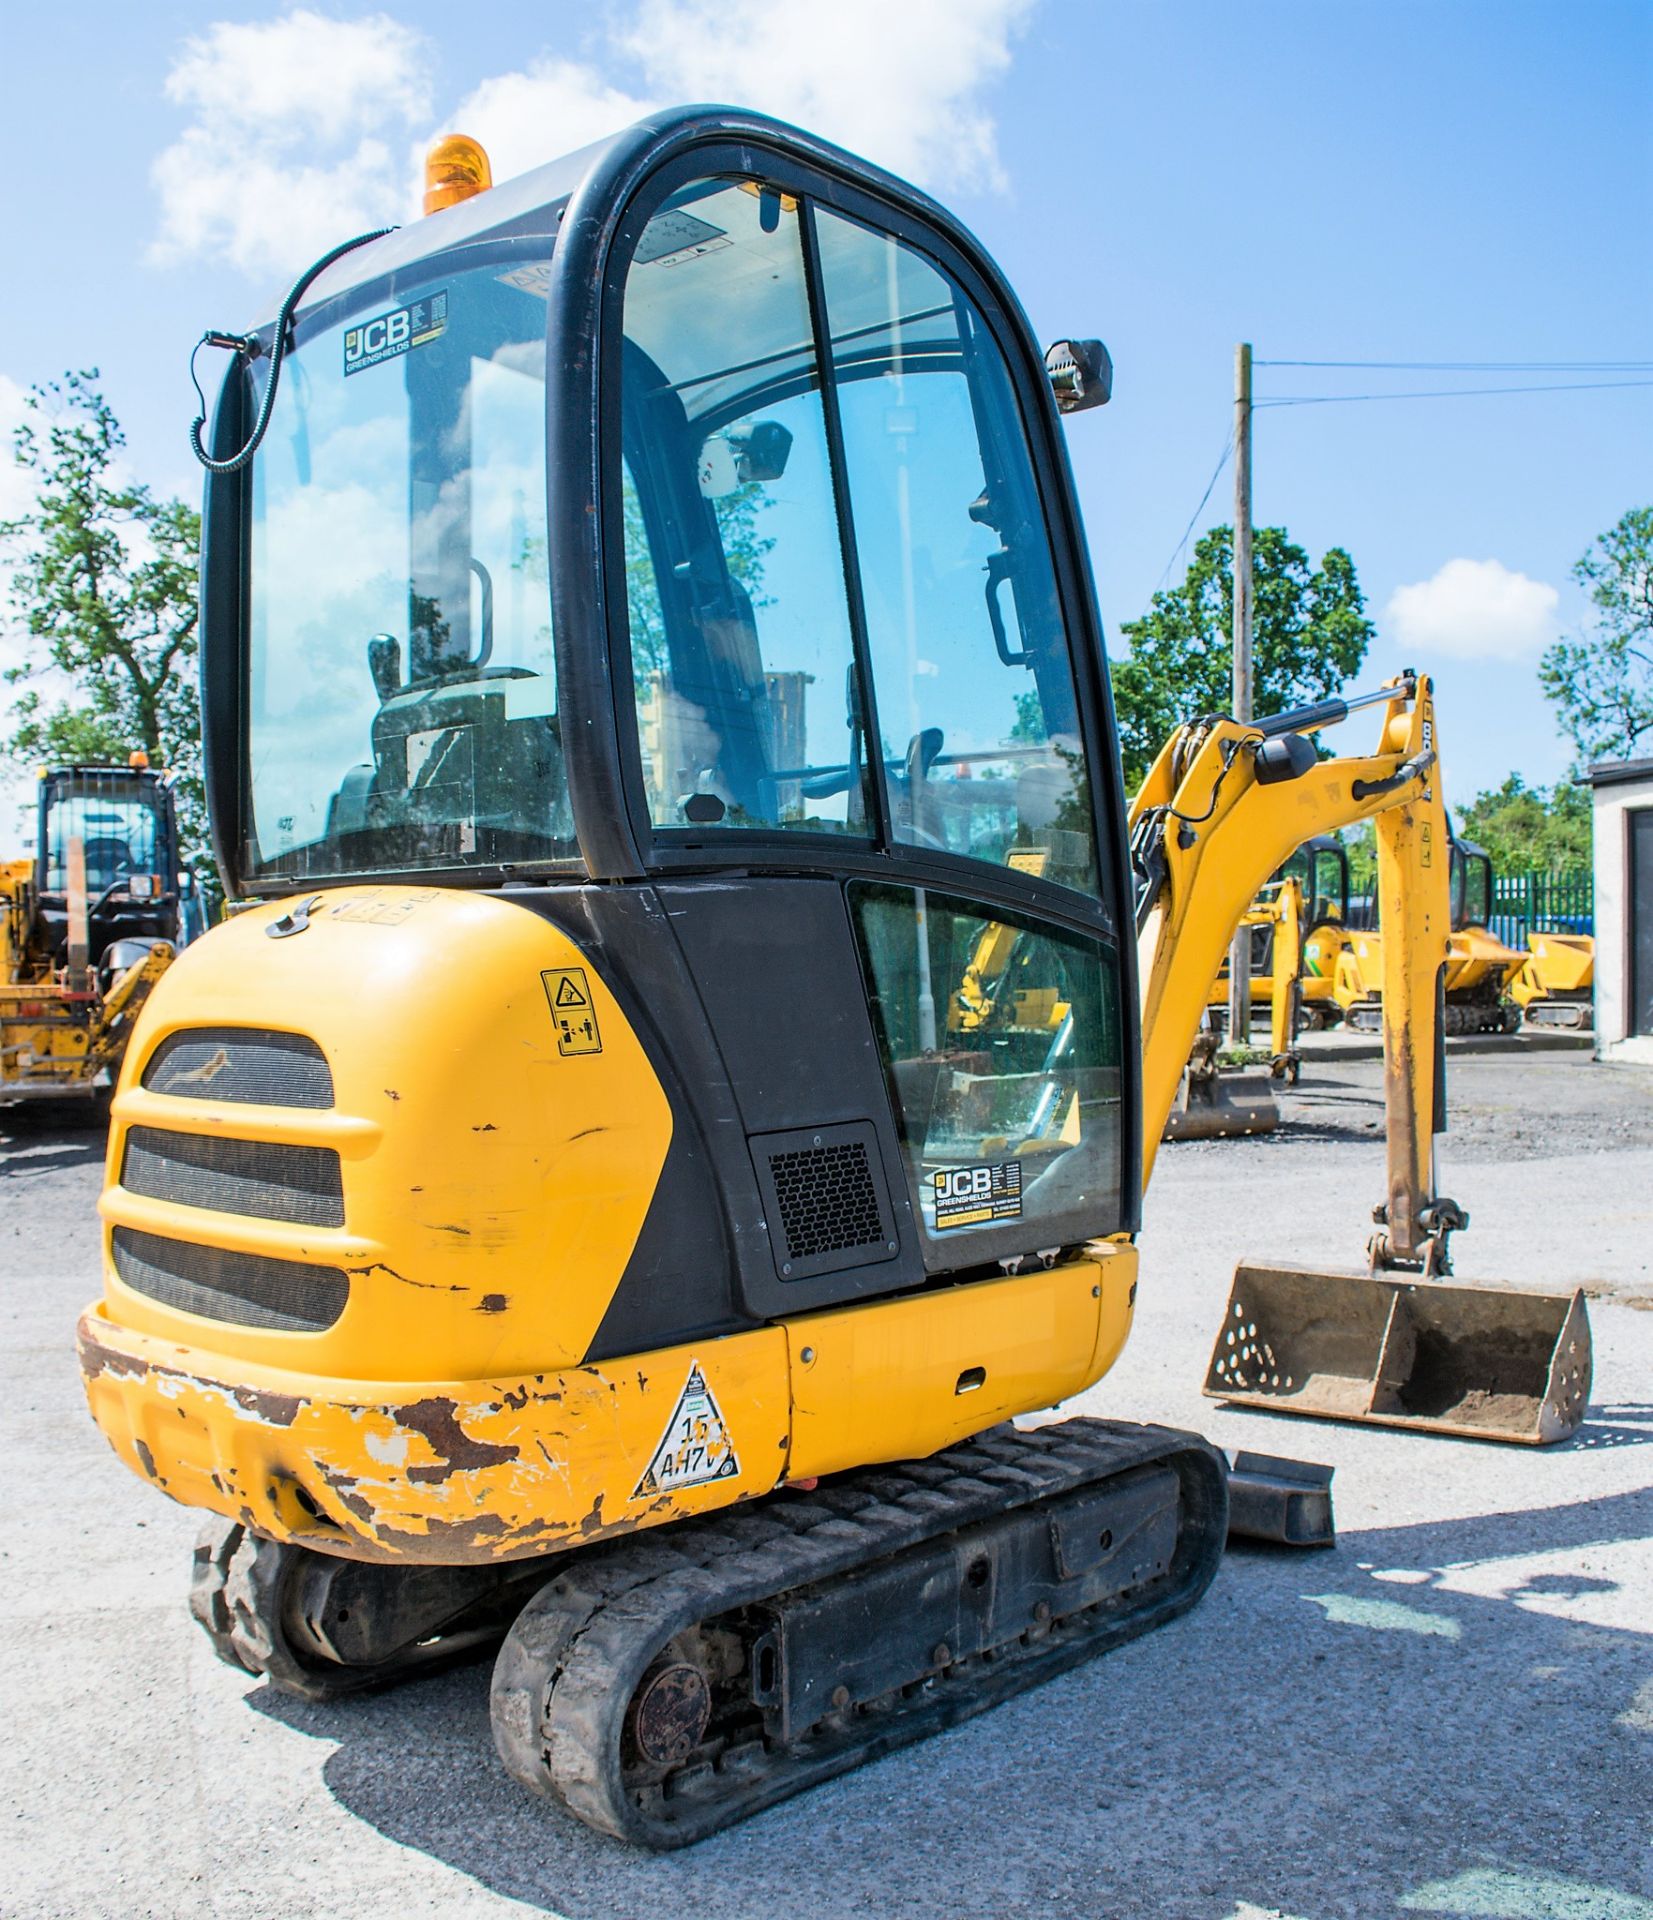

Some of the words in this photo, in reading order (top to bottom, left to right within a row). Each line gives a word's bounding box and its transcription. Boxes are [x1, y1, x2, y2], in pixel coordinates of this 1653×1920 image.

[346, 310, 409, 362] JCB
[346, 341, 410, 372] GREENSHIELDS
[936, 1168, 991, 1198] JCB
[937, 1192, 992, 1207] GREENSHIELDS
